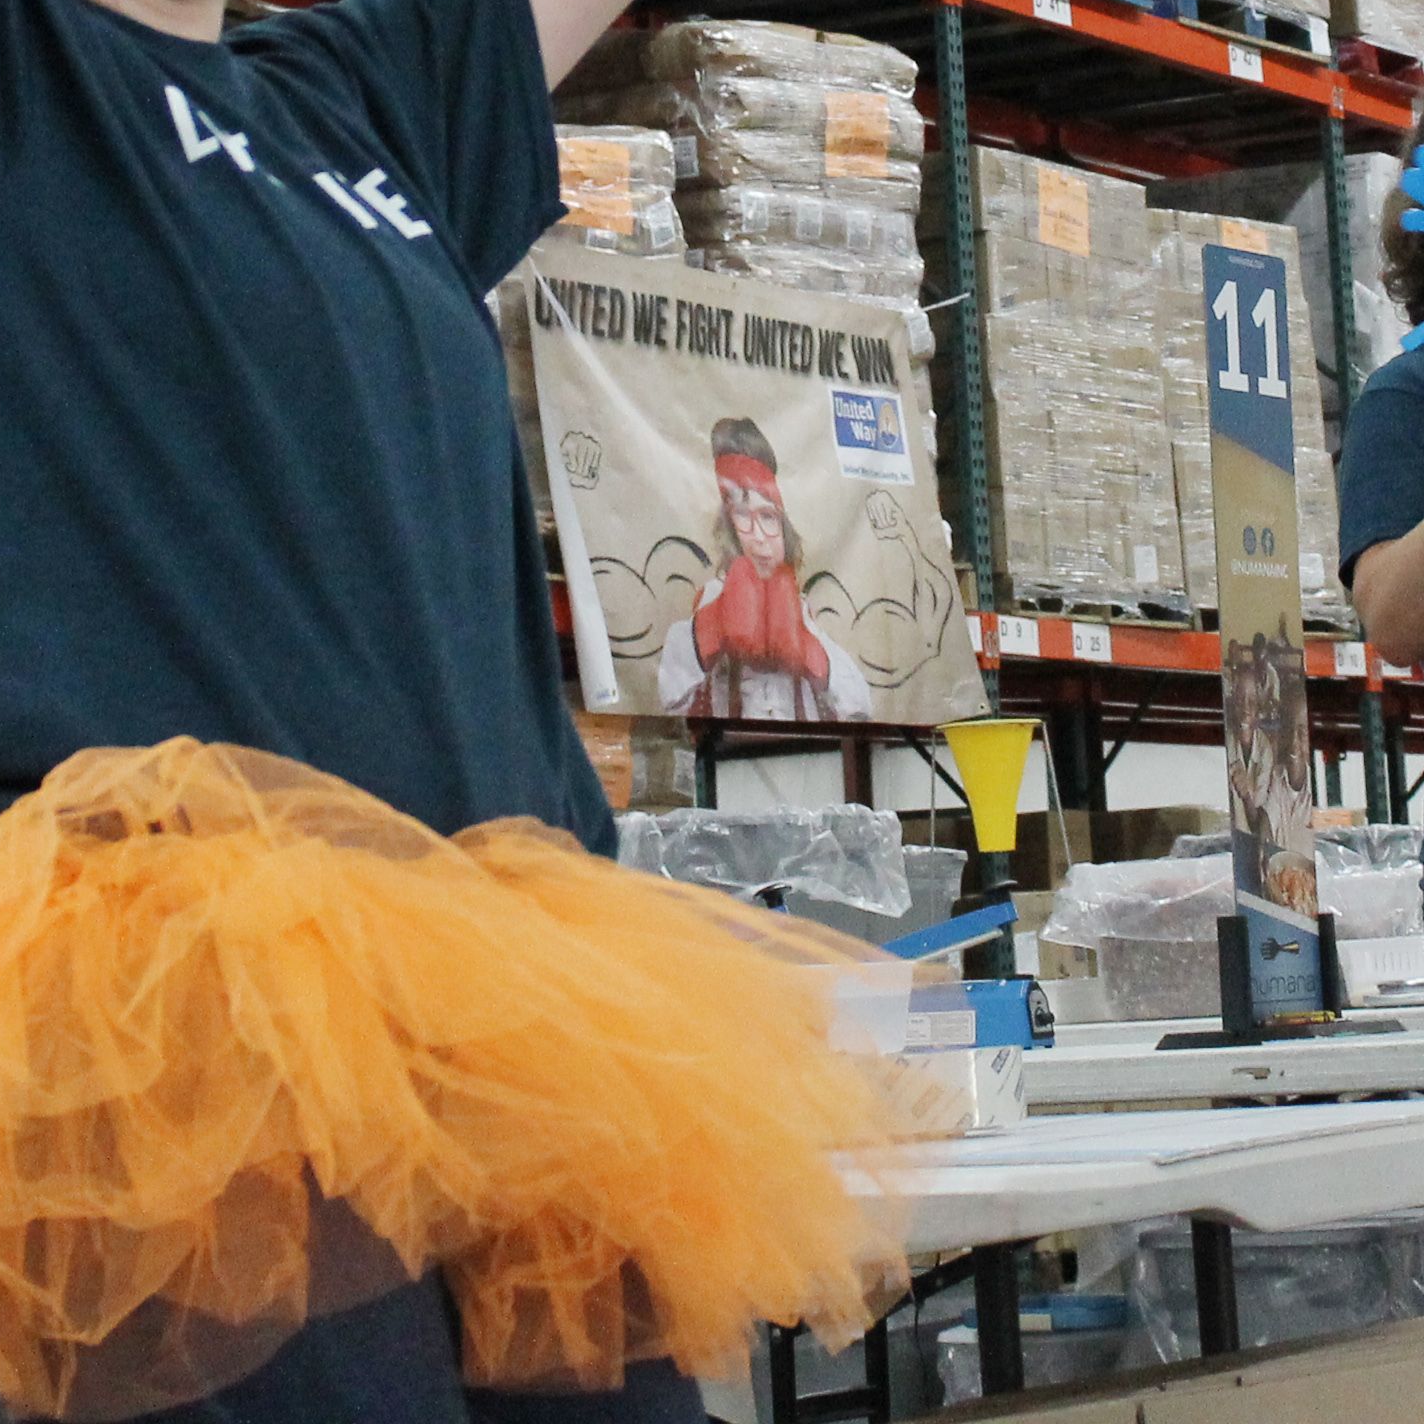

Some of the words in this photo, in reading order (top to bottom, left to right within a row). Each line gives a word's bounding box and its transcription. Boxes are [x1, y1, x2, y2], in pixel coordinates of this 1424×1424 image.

[535, 276, 626, 340] UNITED
[632, 291, 668, 347] WE
[676, 299, 738, 361] FIGHT.
[744, 313, 813, 374] UNITED
[819, 327, 849, 379] WE
[1212, 280, 1287, 399] 11
[835, 397, 875, 421] United
[850, 420, 876, 448] Way
[1001, 621, 1008, 636] D
[1016, 623, 1022, 638] 9
